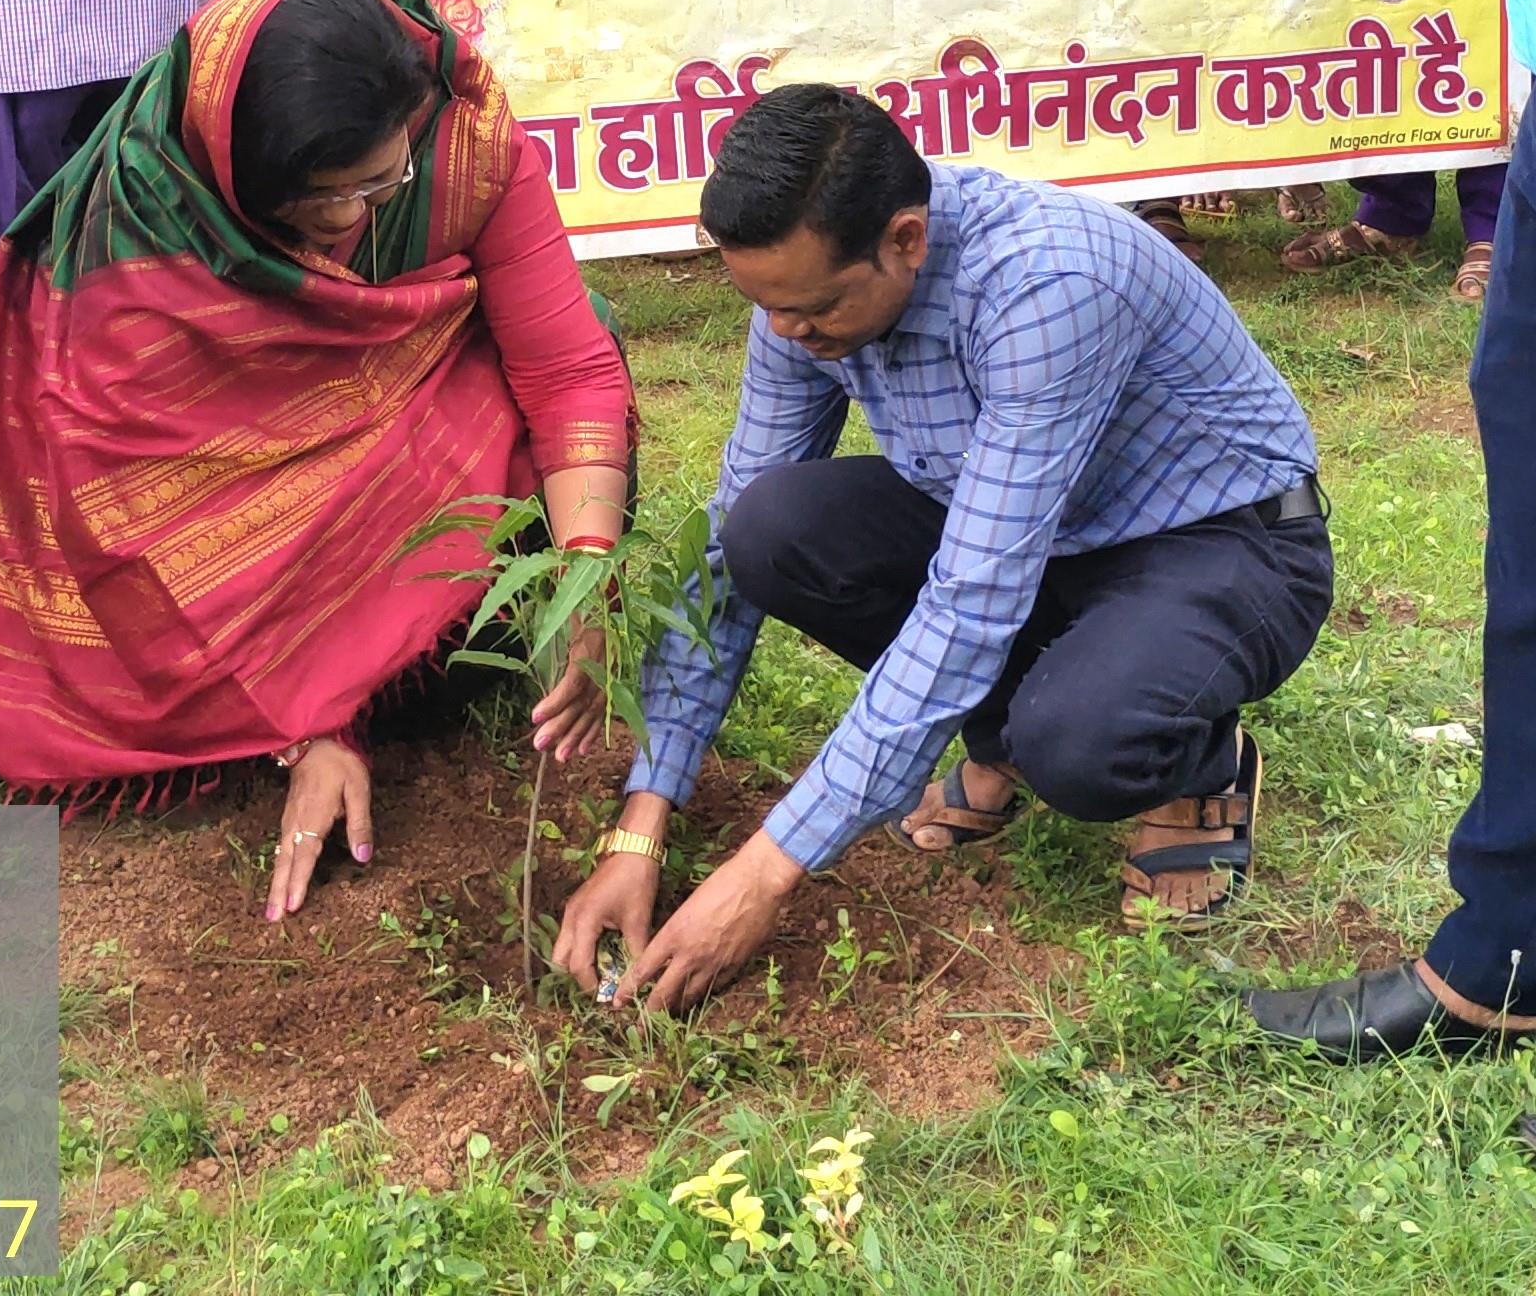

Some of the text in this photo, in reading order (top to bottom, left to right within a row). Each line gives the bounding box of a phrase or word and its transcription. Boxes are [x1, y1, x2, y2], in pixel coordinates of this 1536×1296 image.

[1211, 20, 1404, 126] करती
[1413, 11, 1484, 114] है.
[1329, 130, 1406, 151] Magendra
[1410, 128, 1442, 142] Flax
